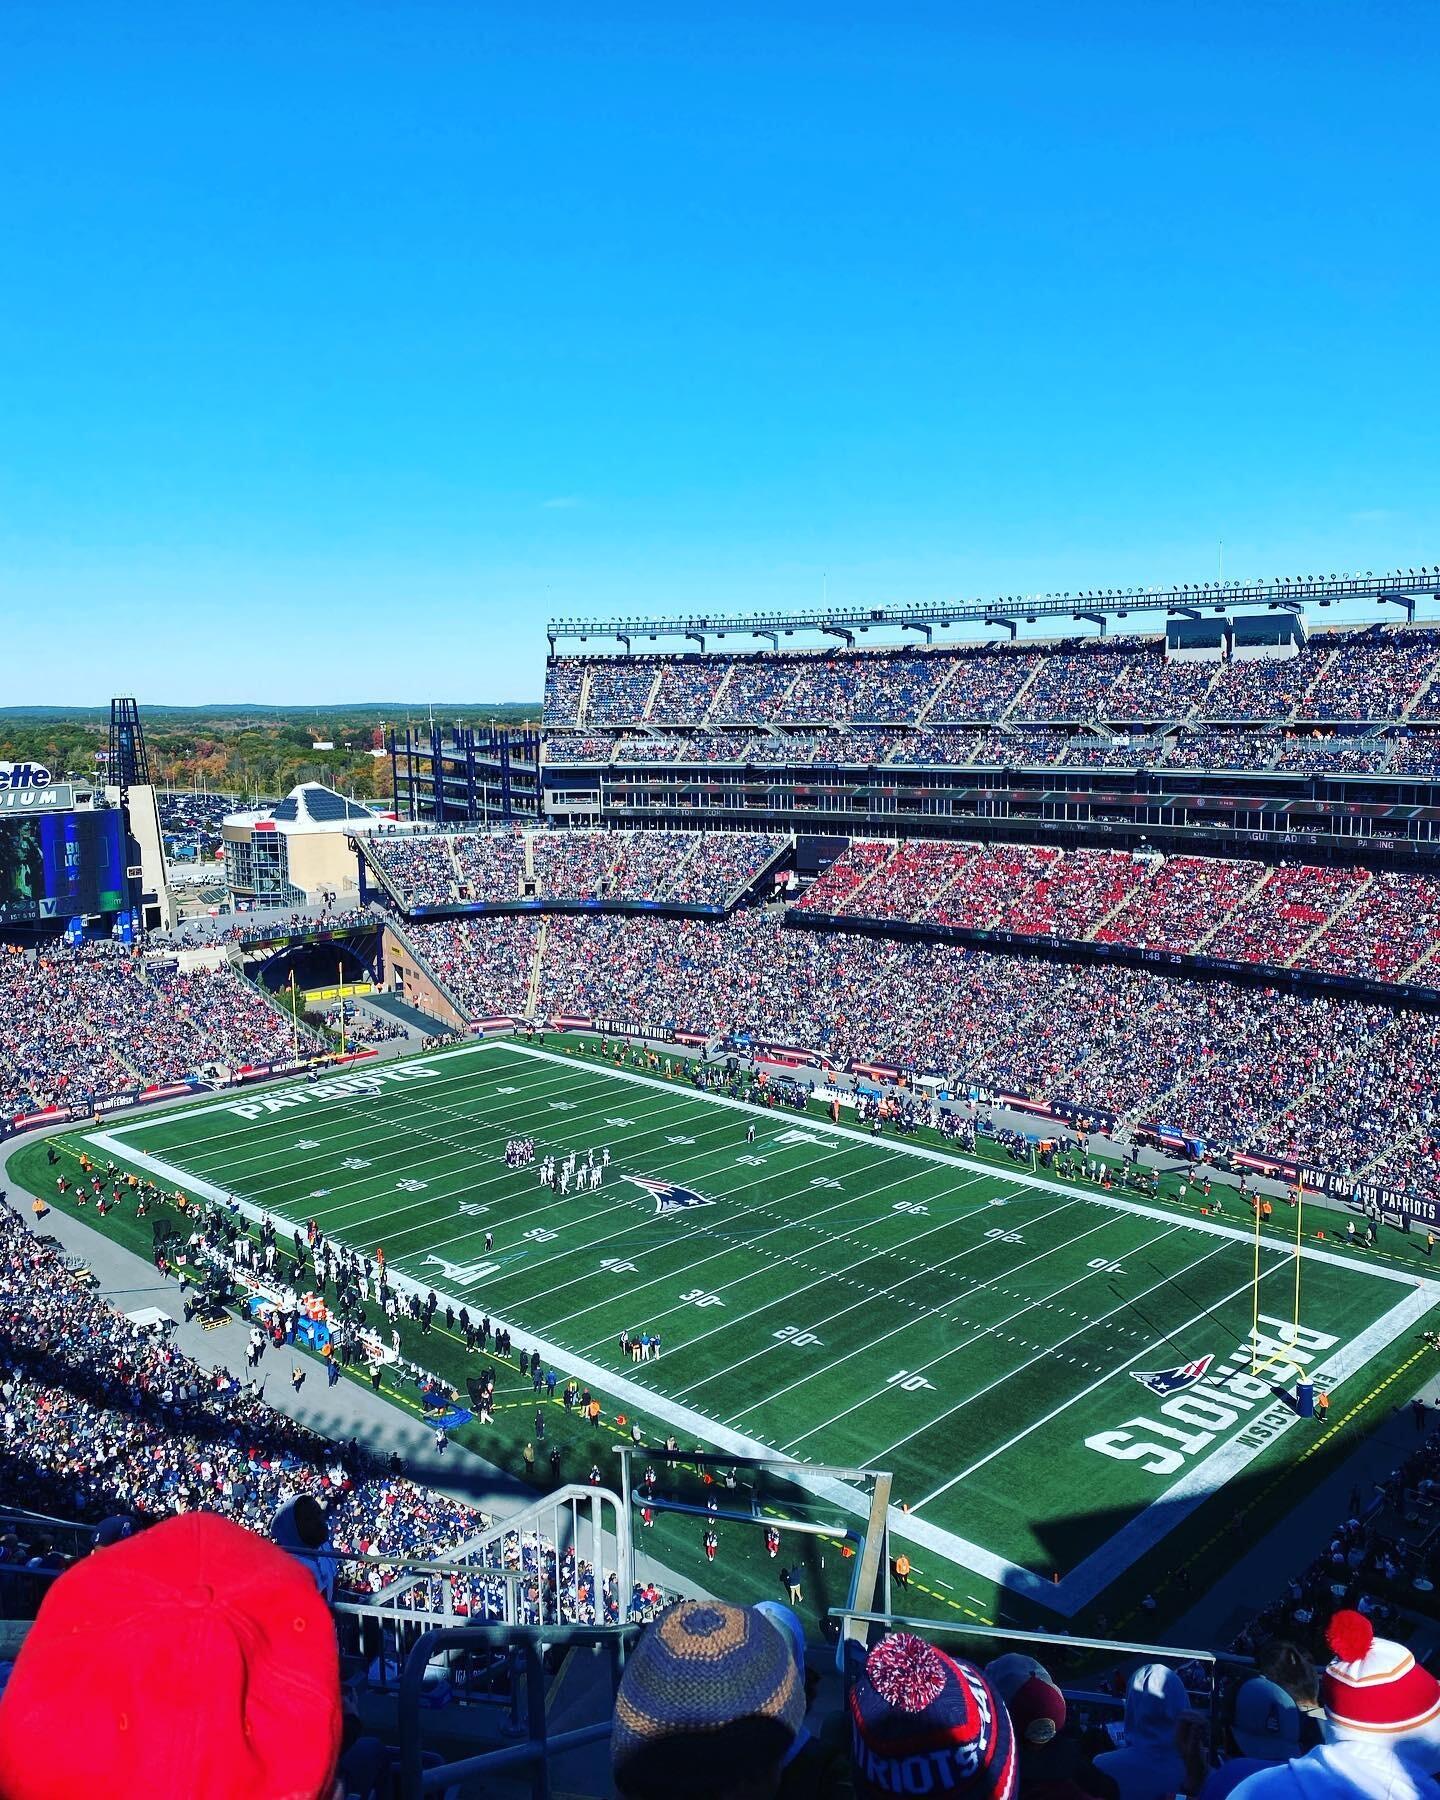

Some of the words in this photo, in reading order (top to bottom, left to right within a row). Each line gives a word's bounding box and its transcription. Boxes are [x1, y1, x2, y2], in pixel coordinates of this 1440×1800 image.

[1170, 955, 1182, 964] 25
[595, 1019, 610, 1031] NEW
[612, 1021, 639, 1035] ENGLAND
[227, 1066, 441, 1121] PATRIOTS
[1302, 1169, 1326, 1188] NEW
[1382, 1191, 1436, 1220] PATRIOTS
[459, 1203, 490, 1215] 40
[892, 1201, 928, 1214] 30
[522, 1228, 559, 1242] 50
[984, 1228, 1024, 1243] 20
[600, 1258, 634, 1273] 40
[1086, 1257, 1122, 1273] 10
[679, 1289, 720, 1307] 30
[772, 1326, 817, 1346] 20
[886, 1369, 928, 1391] 10
[1084, 1314, 1341, 1475] PATRIOTS
[1235, 1404, 1297, 1450] ACISM
